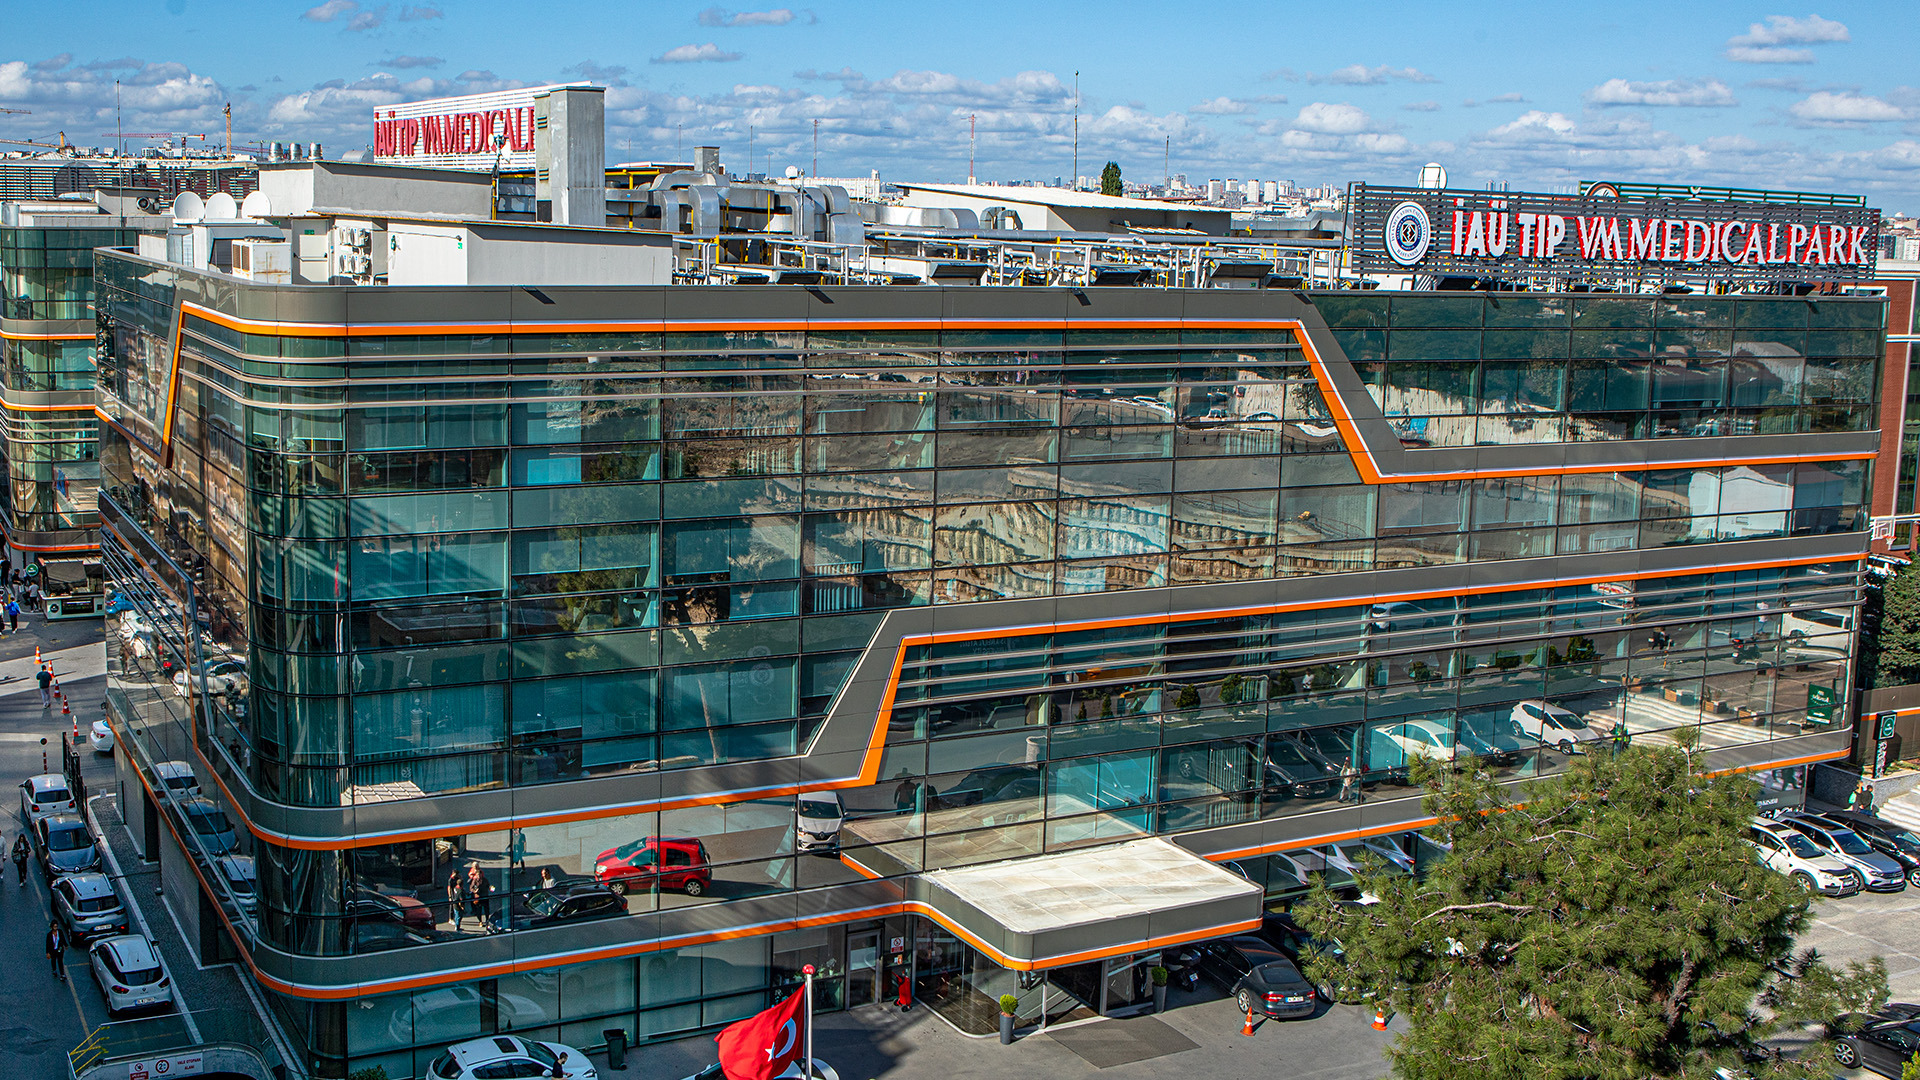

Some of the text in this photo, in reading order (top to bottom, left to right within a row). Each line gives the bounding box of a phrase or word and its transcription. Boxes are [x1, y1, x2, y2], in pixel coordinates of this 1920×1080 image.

[374, 111, 395, 157] İAÜ
[396, 118, 419, 156] TIP
[1451, 198, 1508, 257] İAÜ
[1516, 213, 1566, 258] TIP
